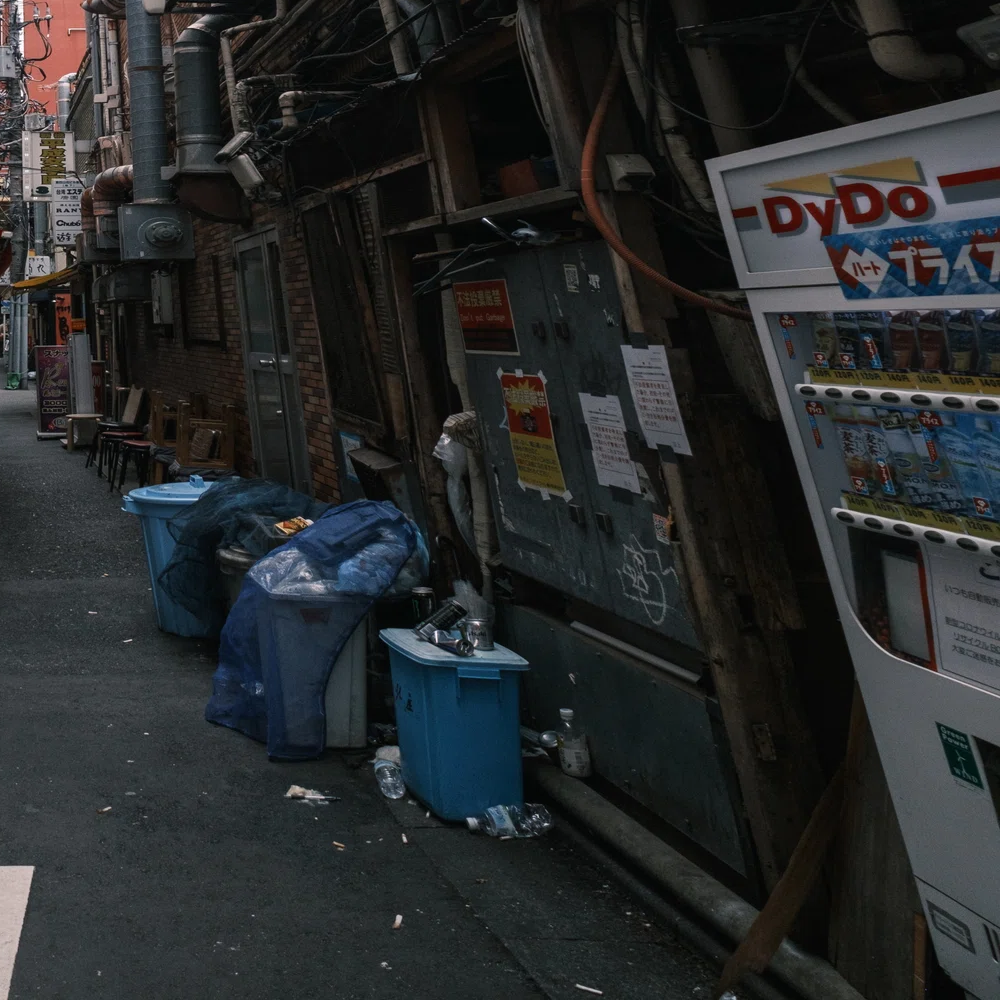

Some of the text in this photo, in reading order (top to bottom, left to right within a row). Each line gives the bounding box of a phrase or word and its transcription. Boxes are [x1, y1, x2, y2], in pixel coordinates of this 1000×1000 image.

[762, 183, 931, 241] DyDo
[851, 261, 881, 277] ハート
[940, 725, 966, 742] Green
[941, 733, 969, 750] Power
